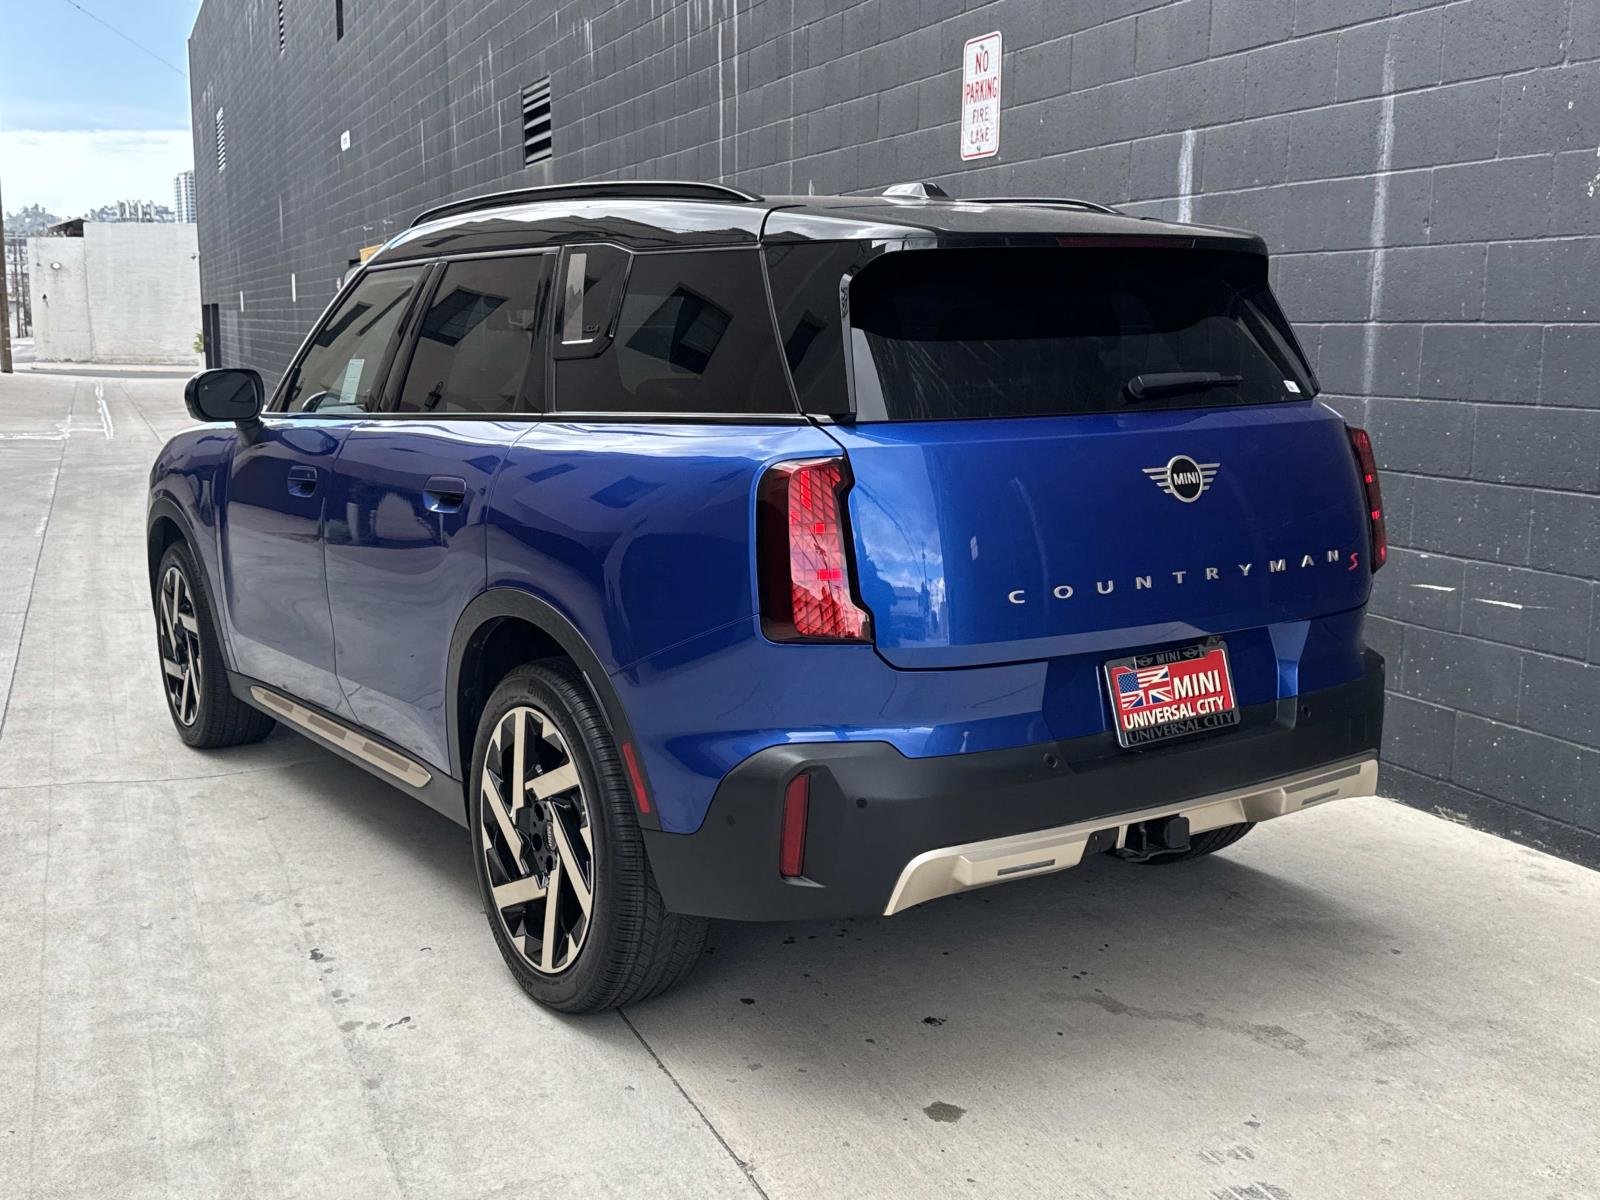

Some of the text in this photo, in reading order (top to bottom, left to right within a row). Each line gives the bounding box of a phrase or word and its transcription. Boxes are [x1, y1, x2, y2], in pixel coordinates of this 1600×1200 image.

[975, 50, 989, 74] NO
[966, 76, 997, 104] PARKING
[972, 106, 989, 124] FIRE
[970, 126, 990, 144] LANE
[1173, 471, 1200, 485] MINI
[1008, 550, 1359, 604] COUNTRYMAN S
[1156, 650, 1180, 664] MINI
[1173, 669, 1221, 699] MINI
[1123, 695, 1225, 729] UNIVERSAL CITY
[1128, 712, 1233, 743] UNIVERSAL CITY
